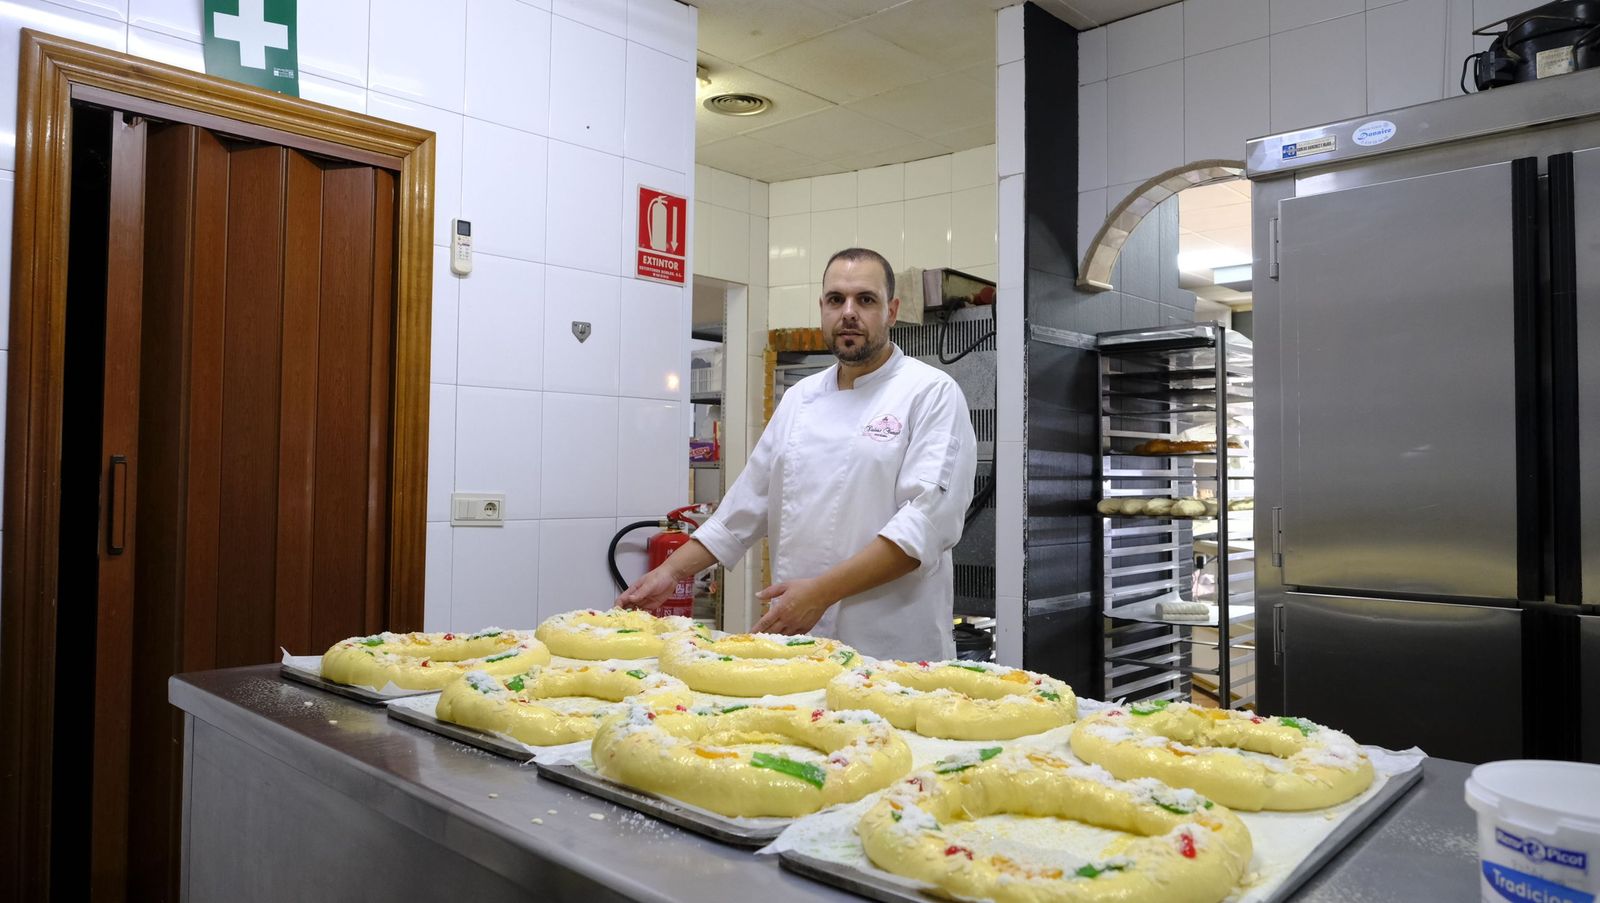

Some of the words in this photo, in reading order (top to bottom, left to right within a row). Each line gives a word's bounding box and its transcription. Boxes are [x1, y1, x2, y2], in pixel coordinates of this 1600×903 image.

[643, 255, 679, 271] EXTINTOR
[1547, 848, 1584, 867] Picot
[1493, 867, 1574, 903] Tradicio
